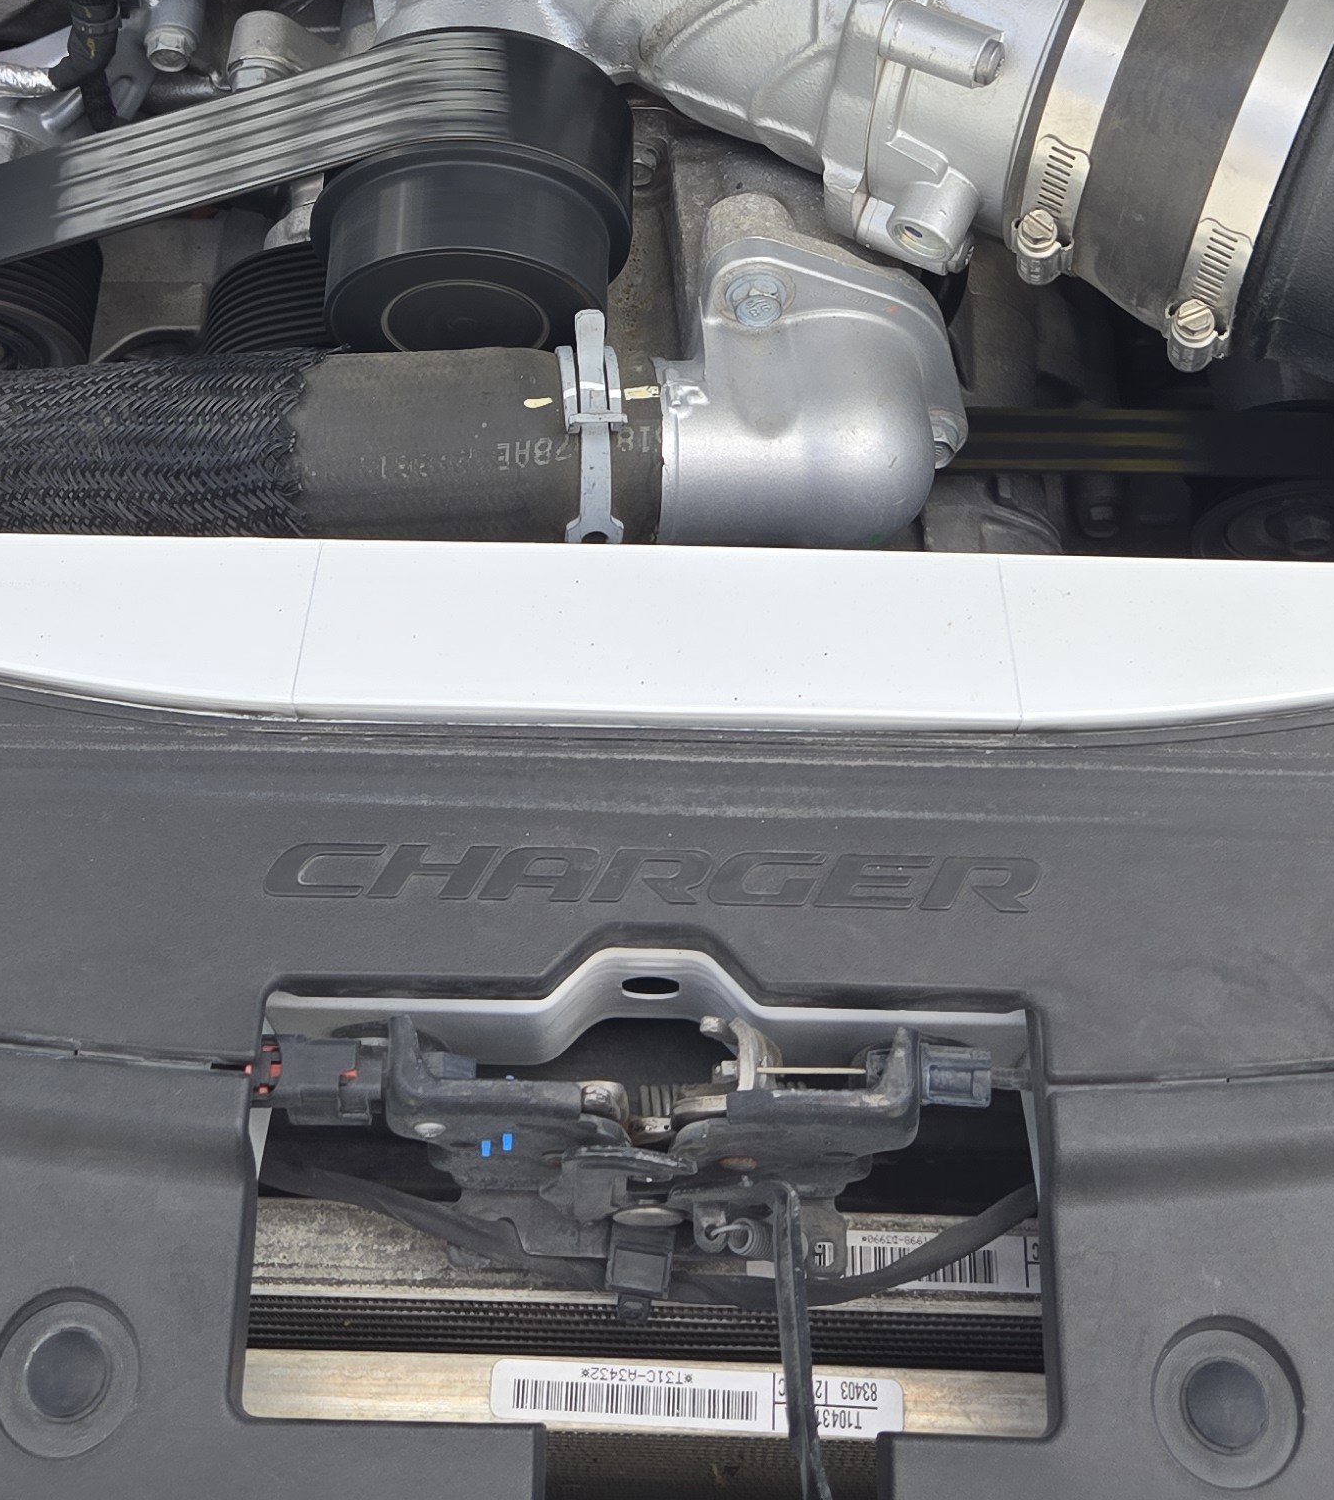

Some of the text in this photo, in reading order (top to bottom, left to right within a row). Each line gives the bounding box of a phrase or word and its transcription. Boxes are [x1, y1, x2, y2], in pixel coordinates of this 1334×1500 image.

[263, 842, 1045, 914] CHARGER
[840, 1380, 879, 1403] 83403
[814, 1408, 864, 1431] T10431
